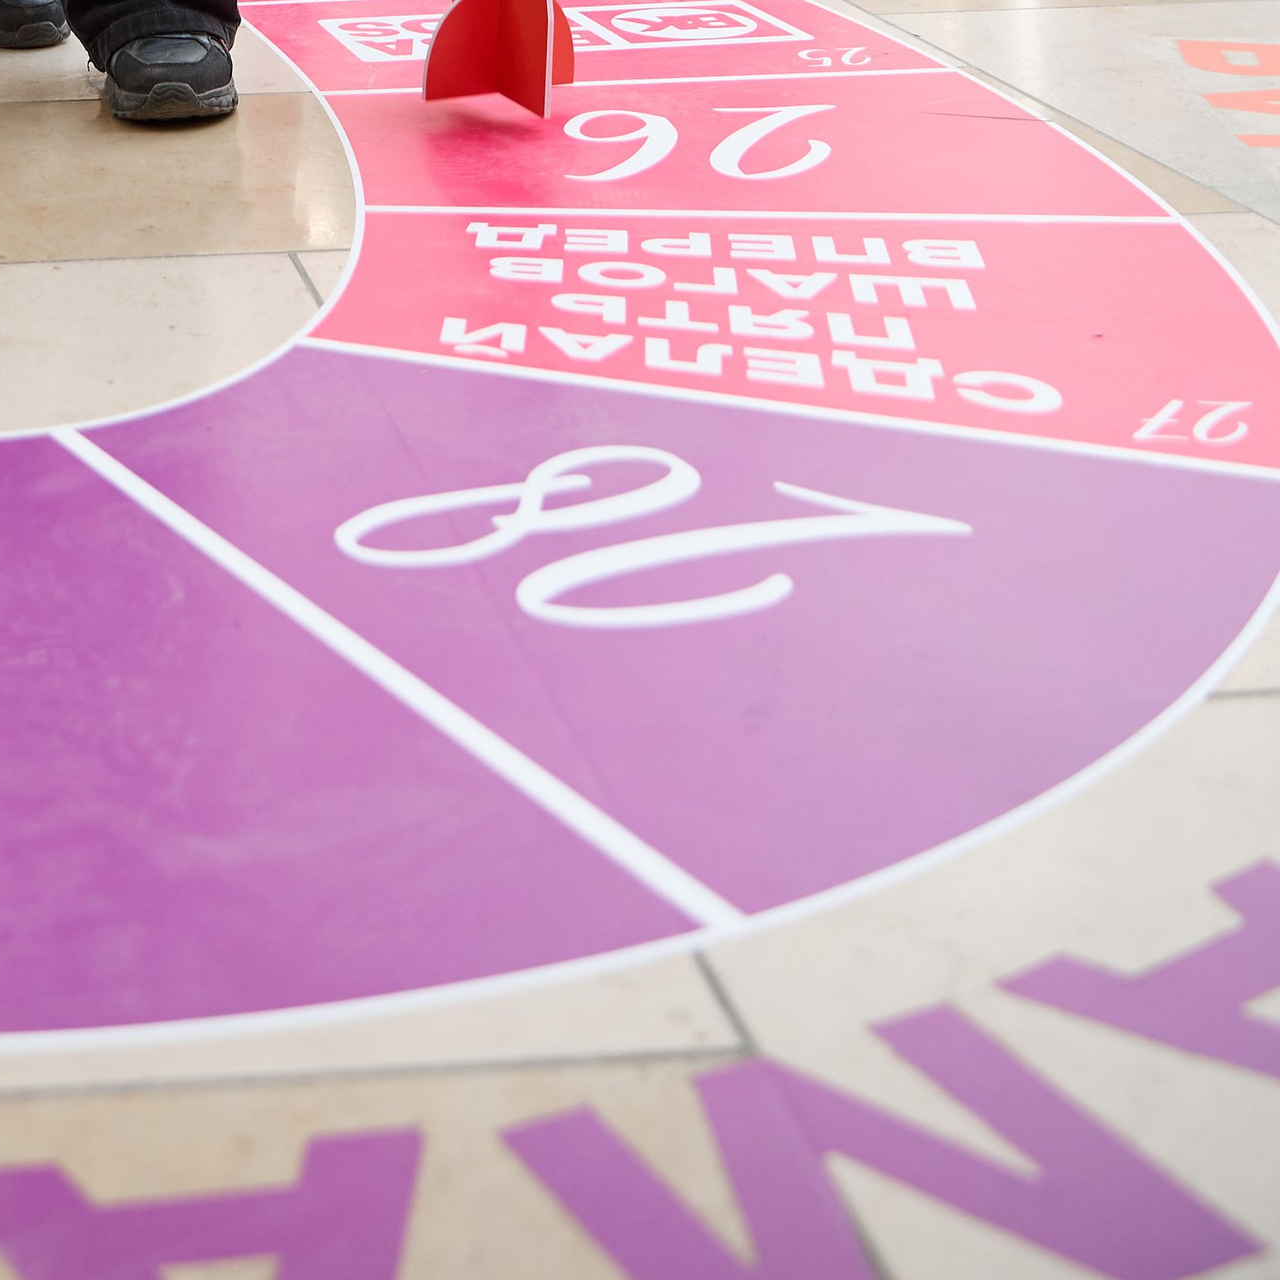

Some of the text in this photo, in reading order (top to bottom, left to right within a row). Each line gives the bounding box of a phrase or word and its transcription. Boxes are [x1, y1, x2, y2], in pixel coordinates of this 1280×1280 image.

[798, 46, 872, 68] 25
[561, 103, 837, 183] 26
[464, 220, 987, 270] ВПЕРЕД
[488, 253, 978, 312] ШАГОВ
[550, 290, 918, 353] ПЯТЬ
[439, 314, 1064, 415] СДЕЛАЙ
[1130, 397, 1254, 446] 27
[332, 442, 974, 628] 28
